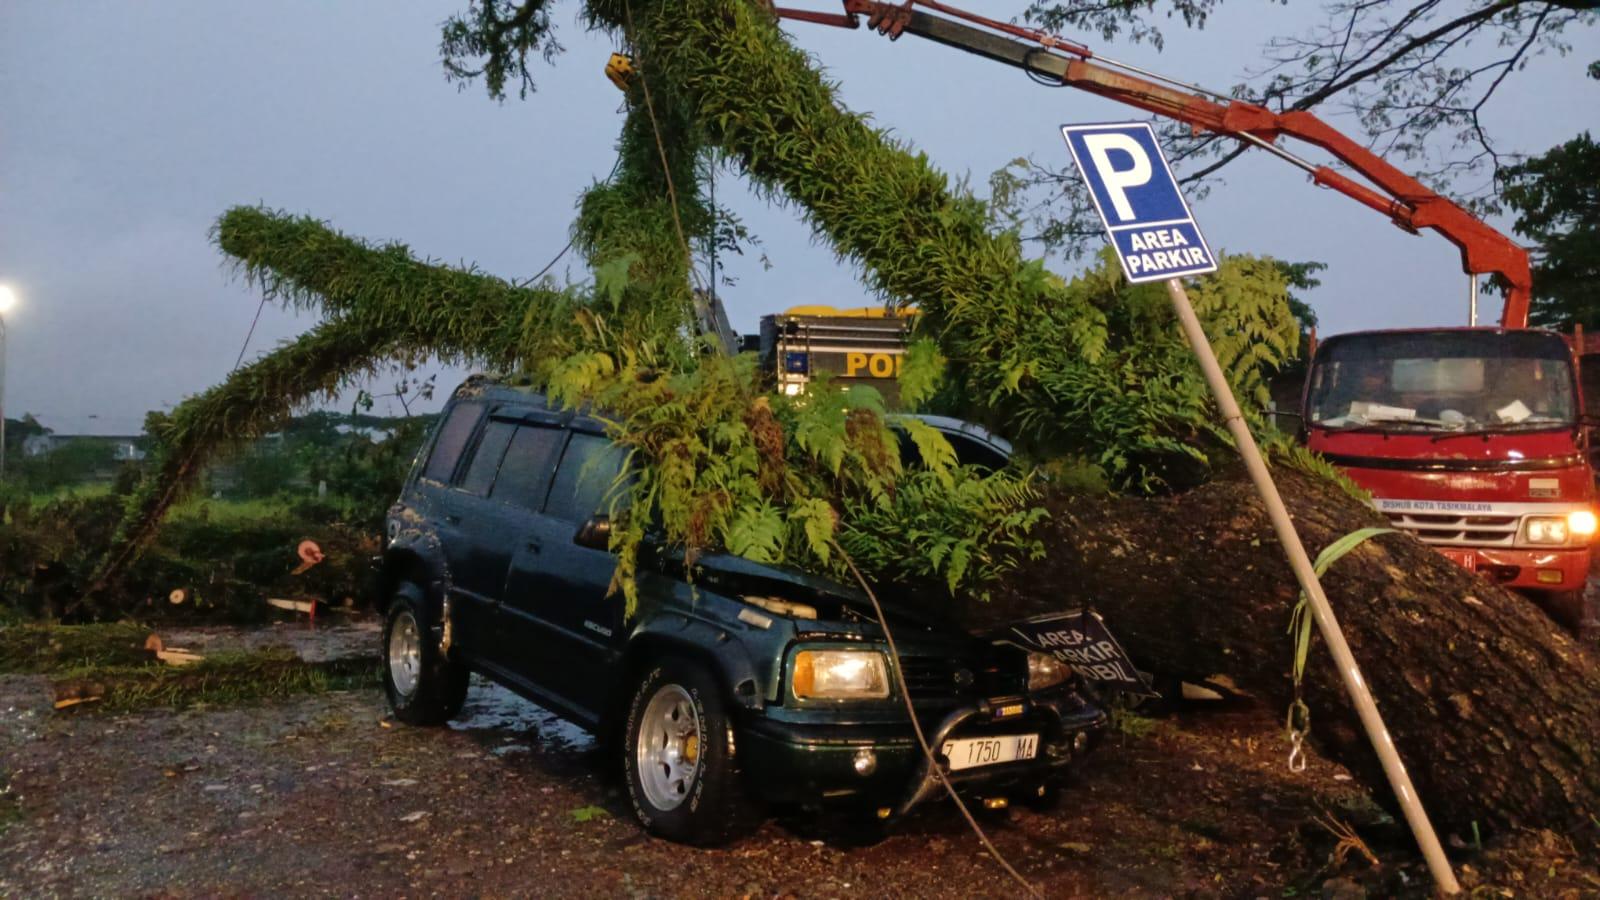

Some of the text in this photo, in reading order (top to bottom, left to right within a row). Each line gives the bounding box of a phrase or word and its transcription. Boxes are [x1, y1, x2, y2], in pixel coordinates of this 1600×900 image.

[1083, 133, 1152, 221] P
[1130, 228, 1188, 251] AREA
[1126, 247, 1208, 274] PARKIR
[1413, 502, 1434, 510] KOTA
[1437, 503, 1493, 512] TASIKMALAYA
[1053, 640, 1122, 664] ARKIR
[968, 740, 1001, 764] 1750
[1015, 738, 1034, 759] MA
